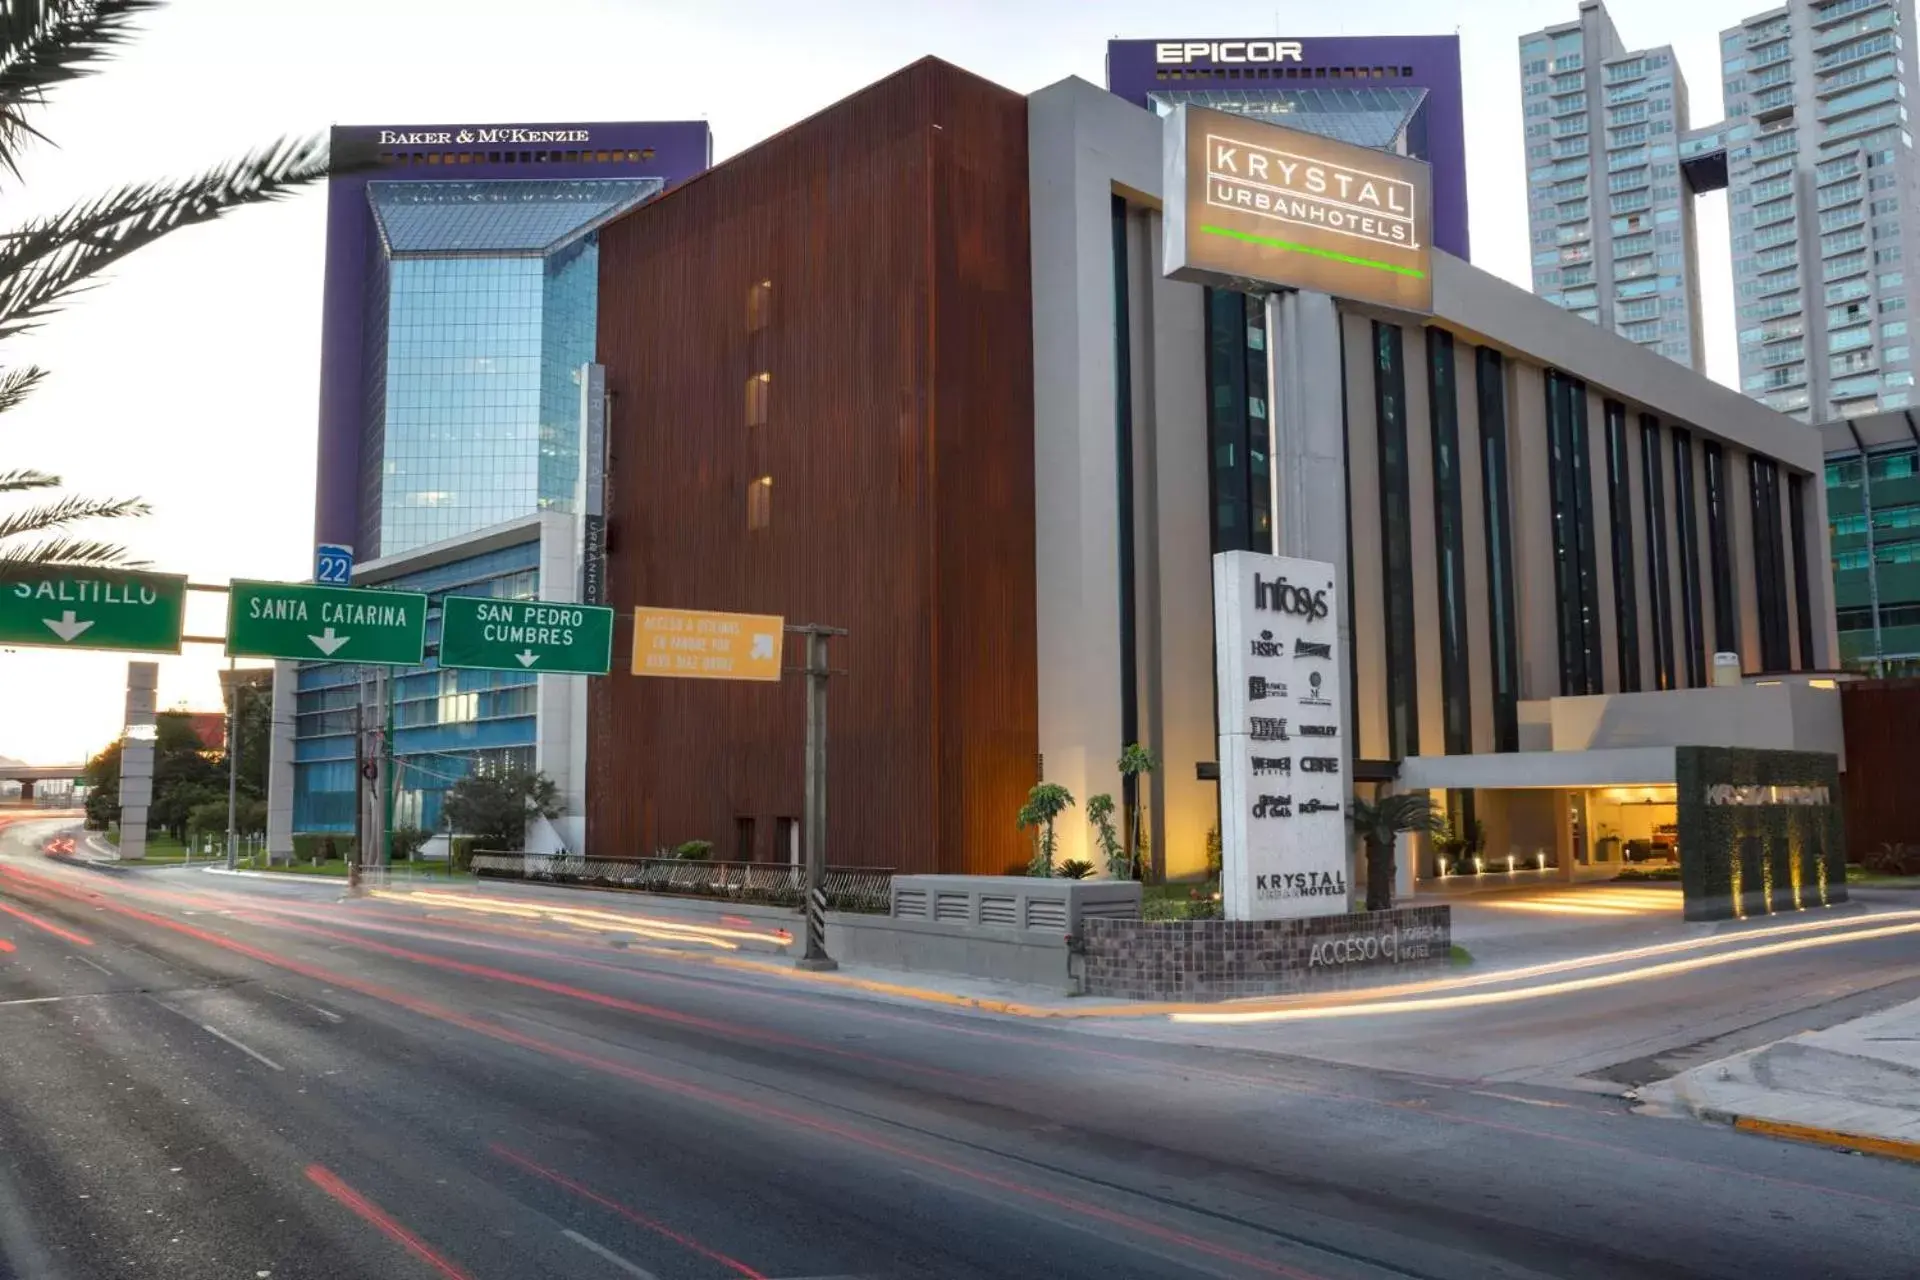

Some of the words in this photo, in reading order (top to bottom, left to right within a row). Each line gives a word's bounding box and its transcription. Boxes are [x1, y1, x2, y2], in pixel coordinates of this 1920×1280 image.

[1156, 41, 1302, 63] EPICOR
[456, 128, 474, 143] &
[1217, 145, 1405, 212] KRYSTAL
[1217, 186, 1405, 240] URBANHOTELS
[320, 557, 347, 581] 22
[14, 579, 157, 605] SALTILLO
[1254, 572, 1328, 622] Infosys
[250, 597, 308, 621] SANTA
[322, 602, 407, 626] CATARINA
[476, 604, 513, 622] SAN
[524, 608, 583, 627] PEDRO
[484, 625, 574, 645] CUMBRES
[1250, 640, 1283, 657] HSBC
[1256, 869, 1344, 890] KRYSTAL
[1308, 934, 1378, 968] ACCESO
[1381, 934, 1394, 958] C
